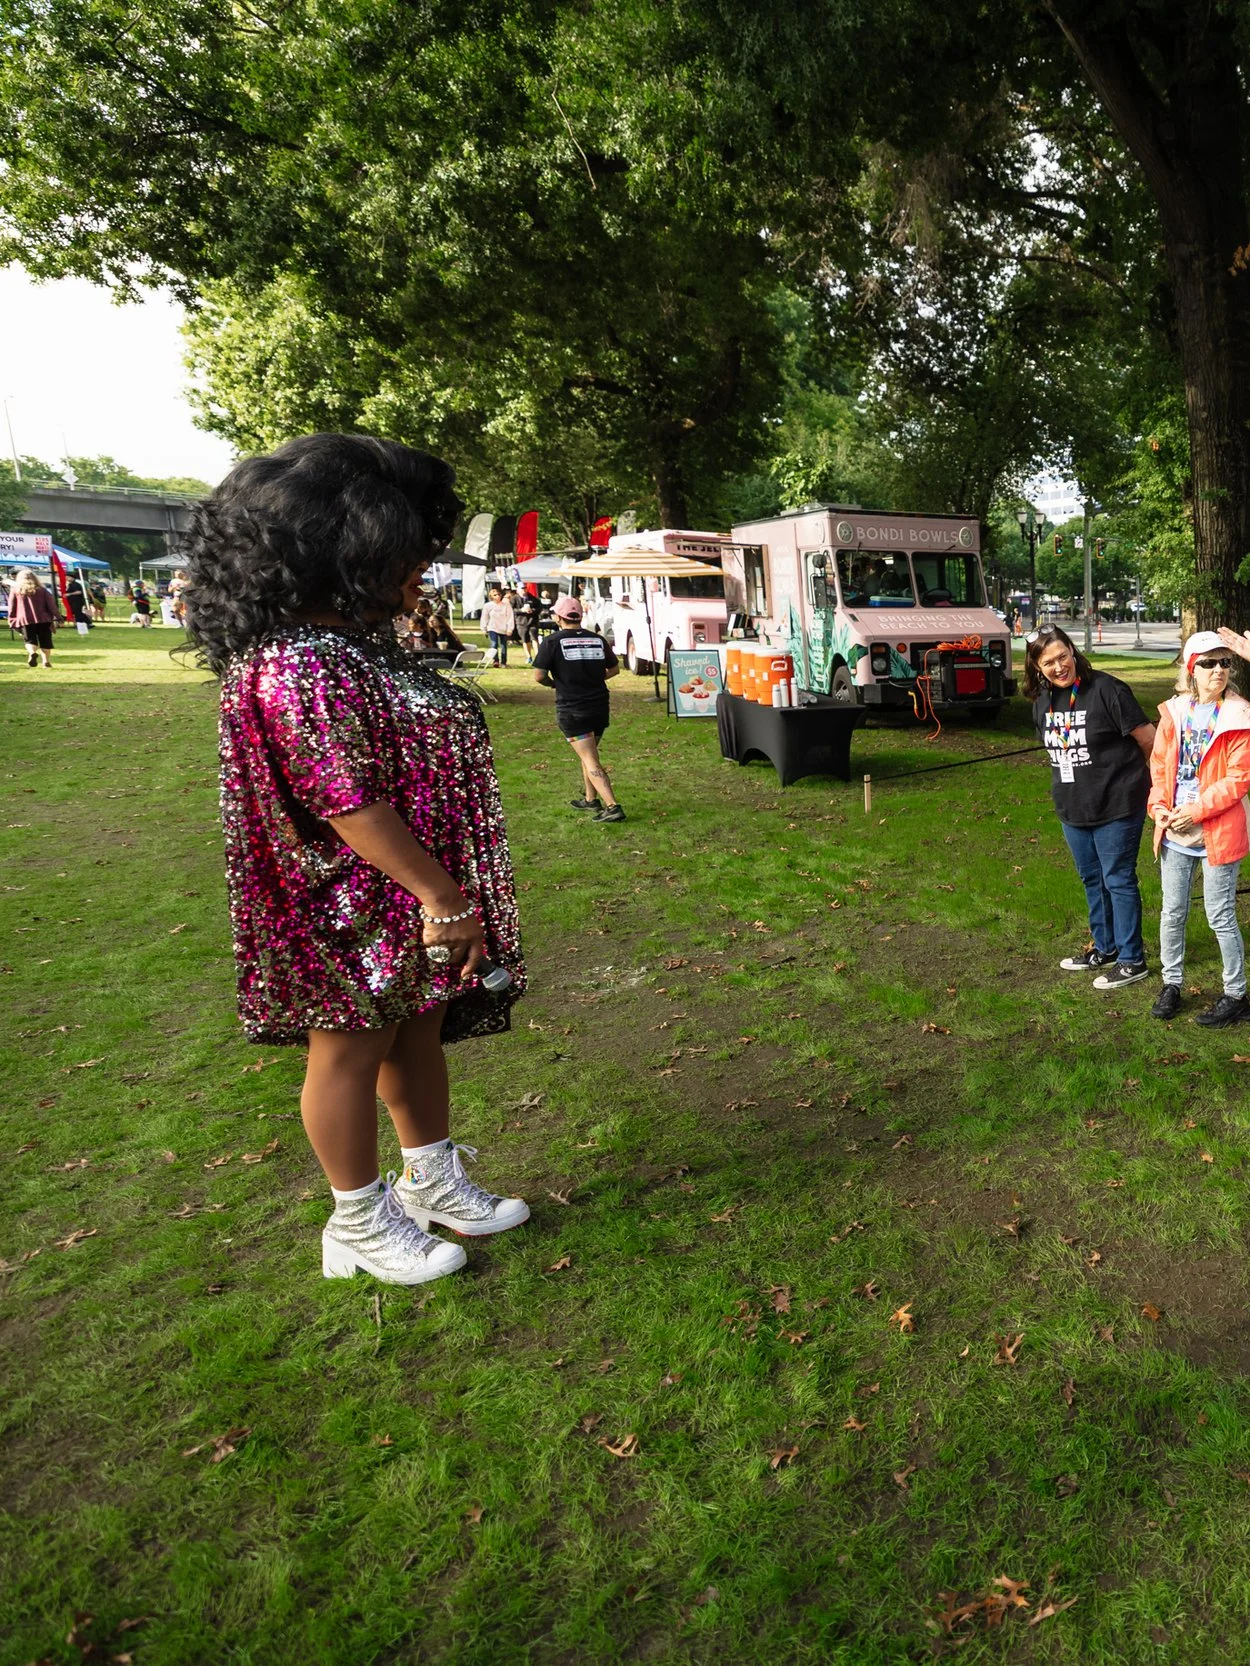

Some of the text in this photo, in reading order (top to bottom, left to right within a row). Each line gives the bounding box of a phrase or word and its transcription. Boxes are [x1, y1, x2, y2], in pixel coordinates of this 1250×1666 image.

[856, 526, 959, 543] BONDI BOWLS
[877, 613, 976, 623] BRINGING THE
[880, 622, 926, 630] BEACH
[955, 620, 985, 628] YOU
